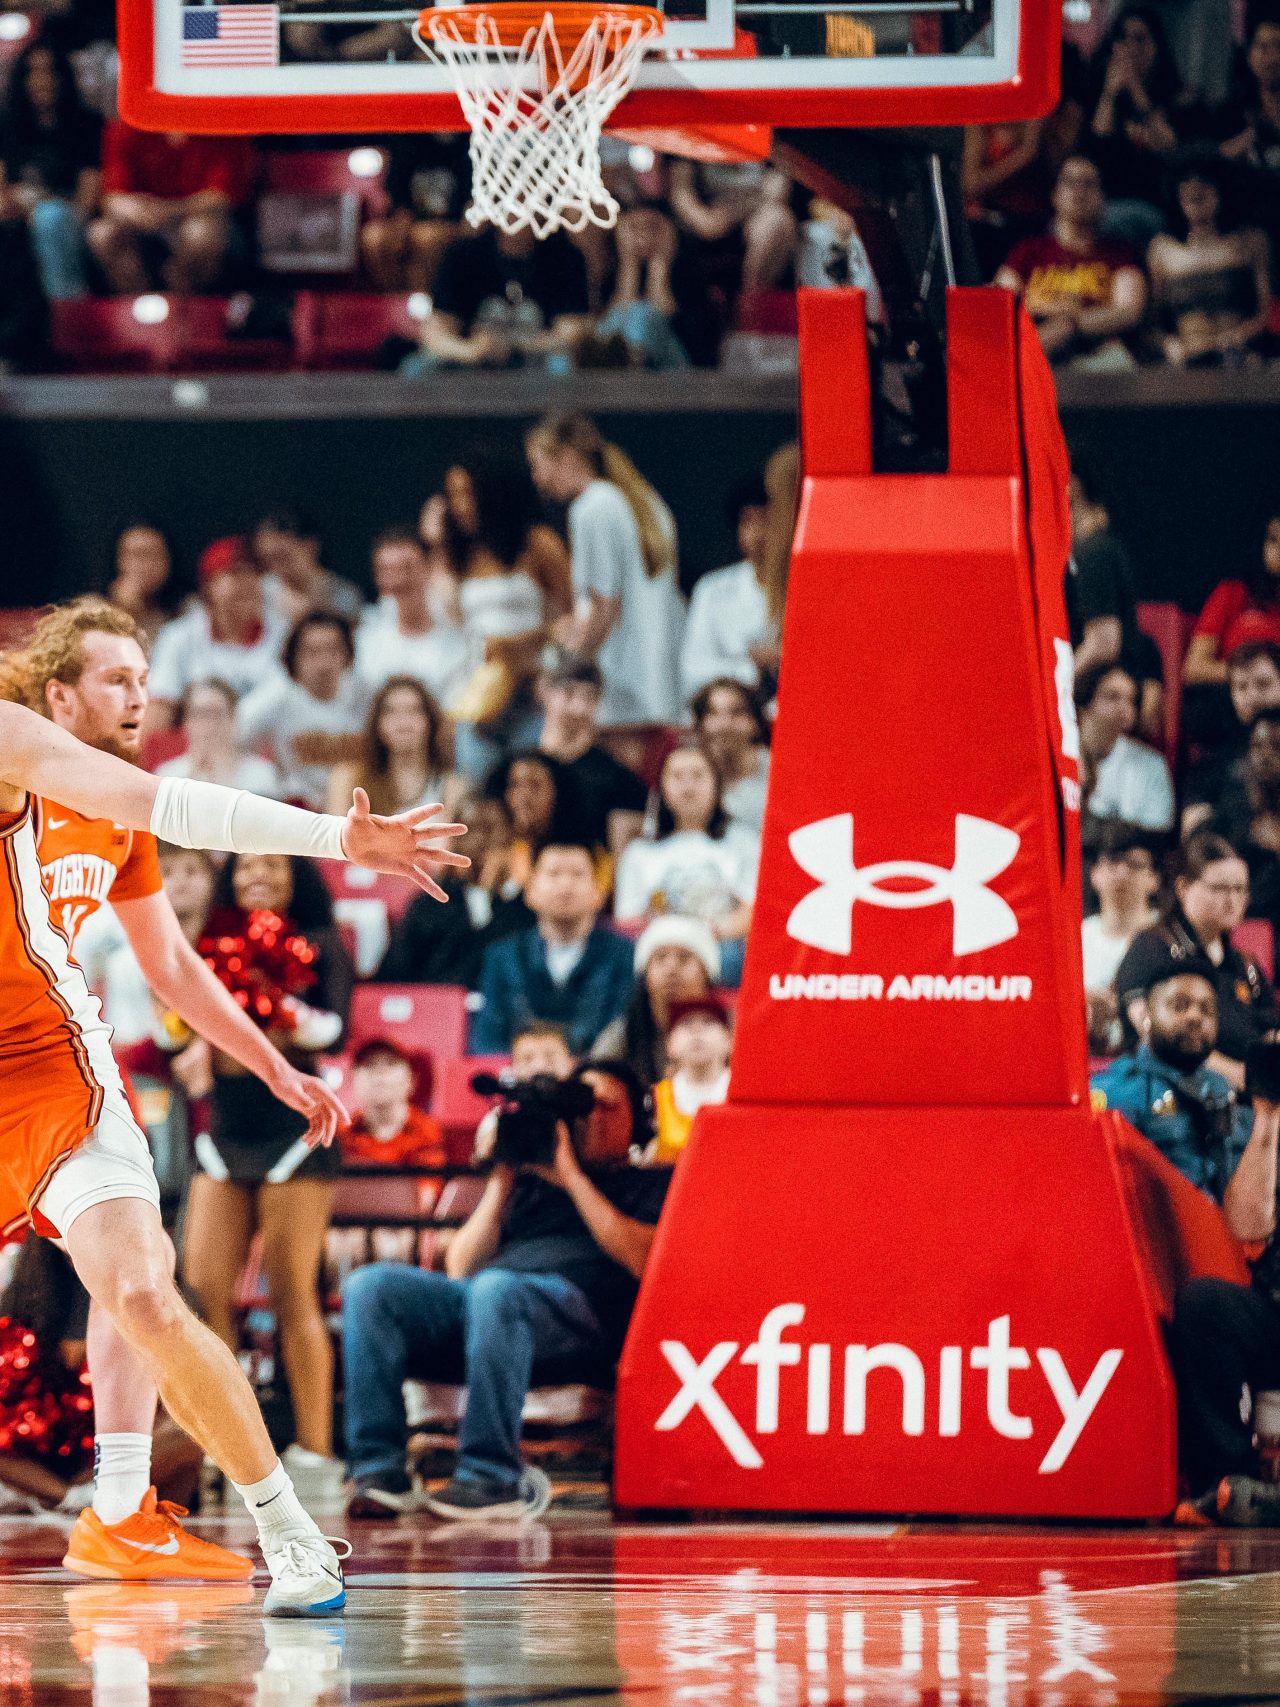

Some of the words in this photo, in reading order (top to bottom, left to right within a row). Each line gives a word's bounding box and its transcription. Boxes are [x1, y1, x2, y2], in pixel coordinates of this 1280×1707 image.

[769, 973, 884, 1001] UNDER
[886, 974, 1032, 1002] ARMOUR
[654, 1302, 1125, 1474] xfinity
